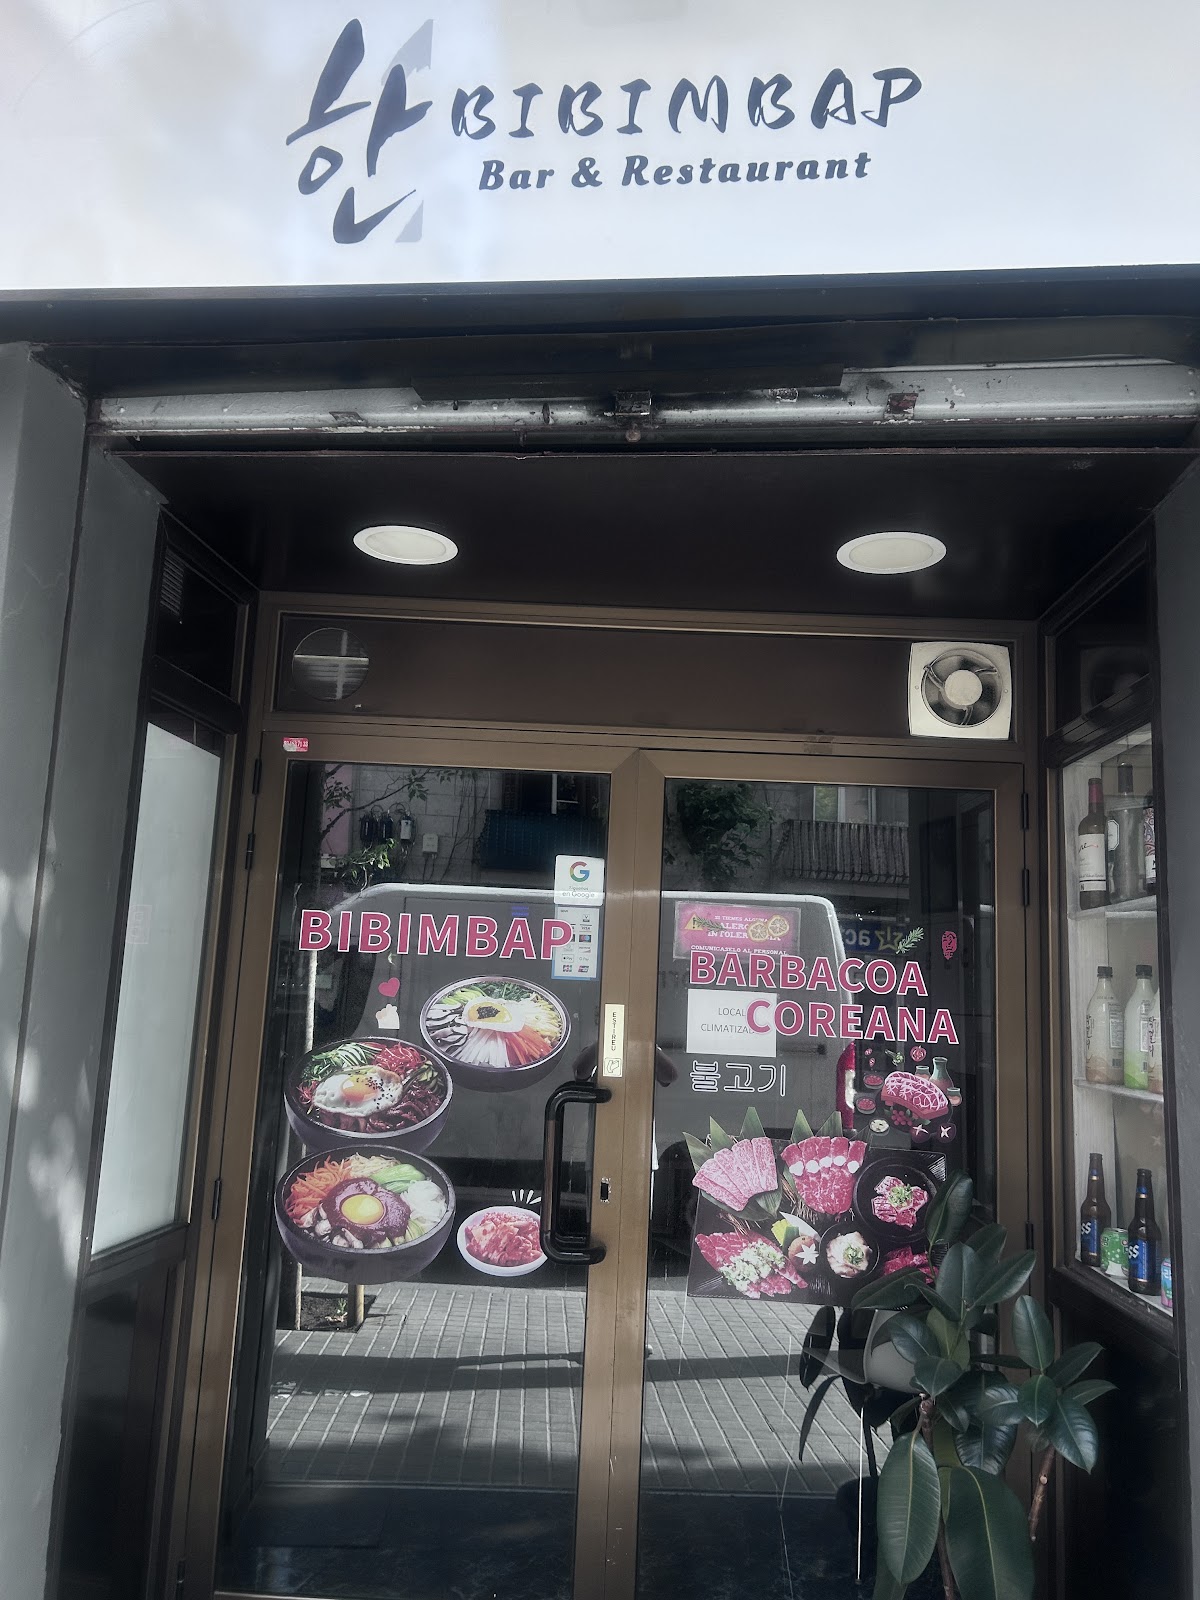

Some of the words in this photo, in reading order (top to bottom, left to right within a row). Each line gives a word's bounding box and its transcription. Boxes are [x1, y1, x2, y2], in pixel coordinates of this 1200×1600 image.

[451, 67, 923, 140] BIBIMBAP
[479, 159, 554, 191] Bar
[571, 158, 603, 188] &
[621, 151, 872, 188] Restaurant
[572, 890, 595, 899] Google
[298, 908, 574, 961] BIBIMBAP
[689, 951, 928, 997] BARBACOA
[700, 1023, 755, 1035] CLIMATIZA
[718, 1007, 746, 1017] LOCAL
[746, 998, 960, 1045] COREANA
[689, 1060, 787, 1097] 불고기
